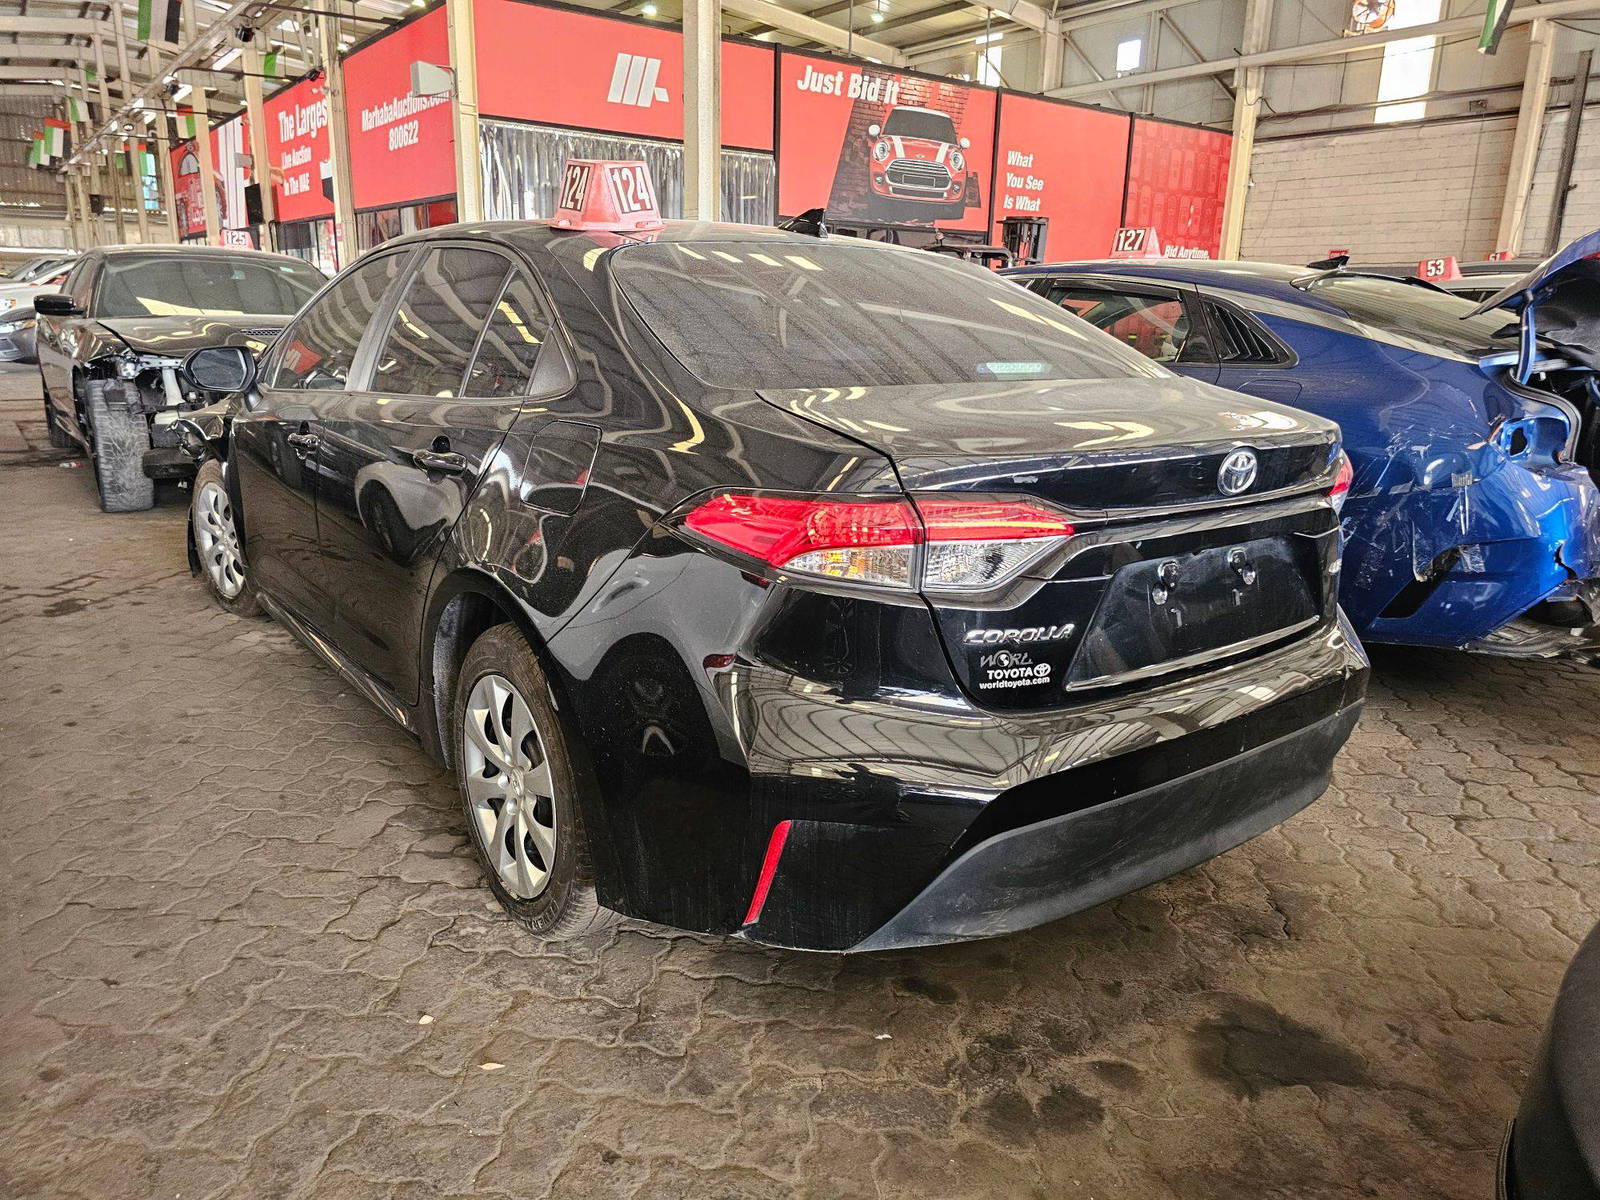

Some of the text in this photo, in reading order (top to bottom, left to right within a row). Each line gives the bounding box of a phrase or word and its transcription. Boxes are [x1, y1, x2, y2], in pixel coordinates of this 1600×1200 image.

[797, 64, 900, 105] Just Bid It
[278, 97, 329, 144] The Larges
[388, 119, 419, 151] 800622
[281, 144, 313, 171] Live Auction
[1007, 150, 1034, 168] What
[289, 176, 300, 196] The
[299, 171, 310, 194] UAE
[561, 165, 590, 210] 124
[610, 165, 653, 213] 124
[1006, 171, 1044, 191] You See
[1002, 193, 1041, 212] Is What
[224, 230, 247, 246] 125
[1118, 229, 1147, 251] 127
[1164, 244, 1179, 258] Bid
[1426, 259, 1445, 277] 53
[962, 623, 1076, 644] COROLLA
[979, 676, 1051, 690] worldtoyota.com
[987, 667, 1034, 680] TOYOTA
